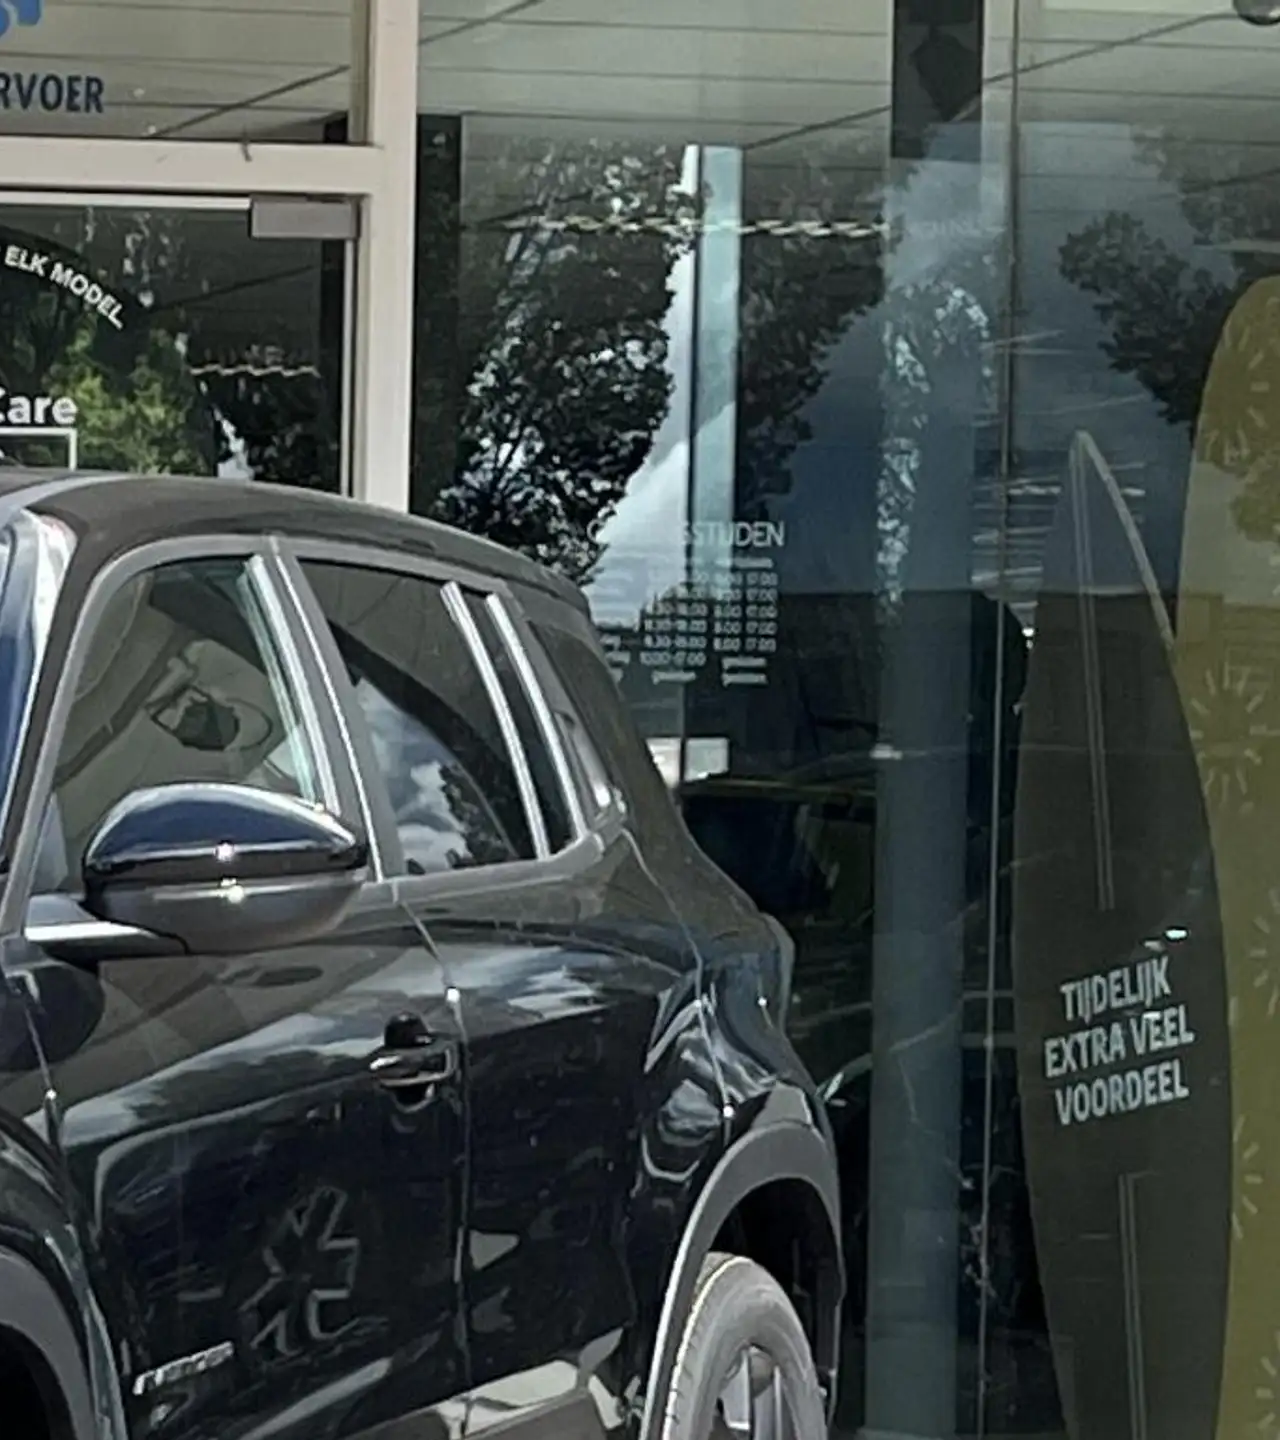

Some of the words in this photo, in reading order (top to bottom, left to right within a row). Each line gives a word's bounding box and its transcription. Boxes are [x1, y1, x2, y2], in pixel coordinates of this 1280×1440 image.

[4, 245, 50, 277] ELK
[49, 261, 125, 331] MODEL
[1059, 955, 1172, 1024] TIJDELIJK
[1043, 1026, 1127, 1078] EXTRA
[1128, 1004, 1195, 1056] VEEL
[1054, 1059, 1190, 1126] VOORDEEL
